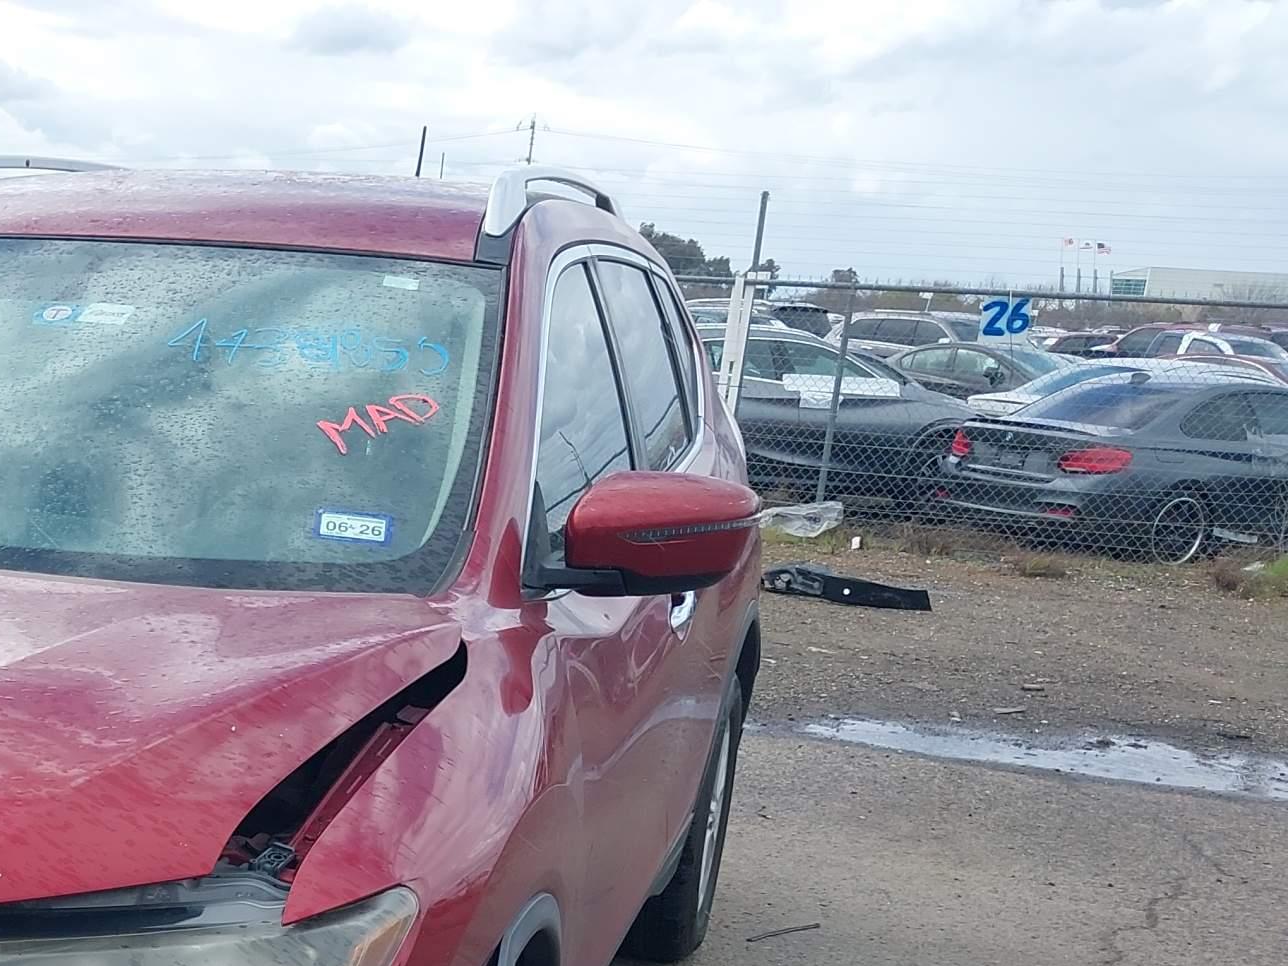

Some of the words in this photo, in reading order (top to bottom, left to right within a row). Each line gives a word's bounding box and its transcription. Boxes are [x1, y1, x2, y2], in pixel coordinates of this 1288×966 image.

[982, 297, 1031, 337] 26
[316, 391, 440, 455] MAD
[325, 520, 349, 533] 06
[359, 523, 383, 537] 26
